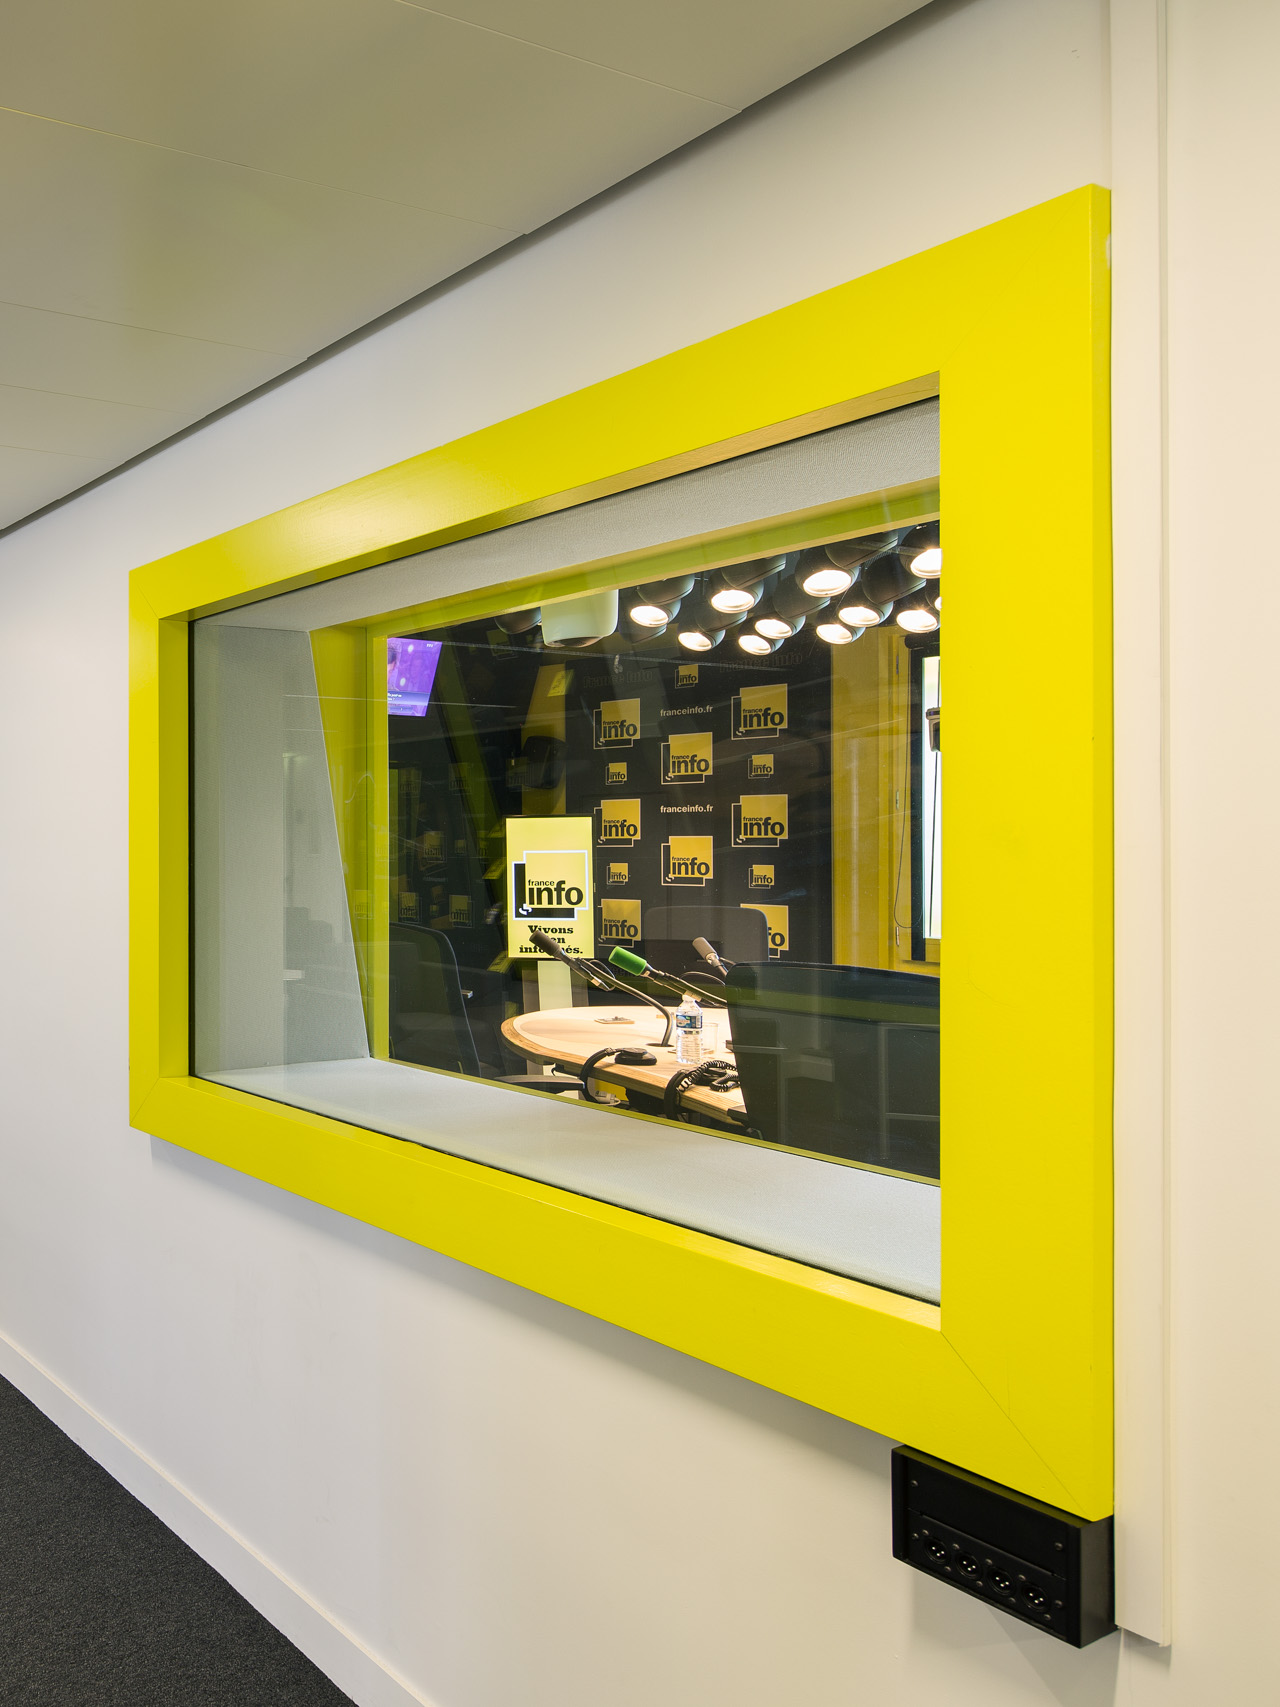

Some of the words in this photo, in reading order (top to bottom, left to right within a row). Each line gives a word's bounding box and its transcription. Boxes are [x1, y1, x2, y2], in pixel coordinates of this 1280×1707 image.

[660, 705, 714, 717] franceinfo.fr
[742, 707, 785, 728] info
[603, 719, 638, 739] info
[671, 754, 710, 774] info
[753, 764, 773, 774] info
[660, 804, 714, 813] franceinfo.fr
[603, 819, 638, 837] info
[743, 817, 785, 837] info
[672, 857, 710, 877] info
[528, 879, 555, 887] france
[753, 874, 773, 884] info
[528, 880, 584, 906] info
[528, 925, 574, 934] Vivons
[604, 919, 639, 938] info
